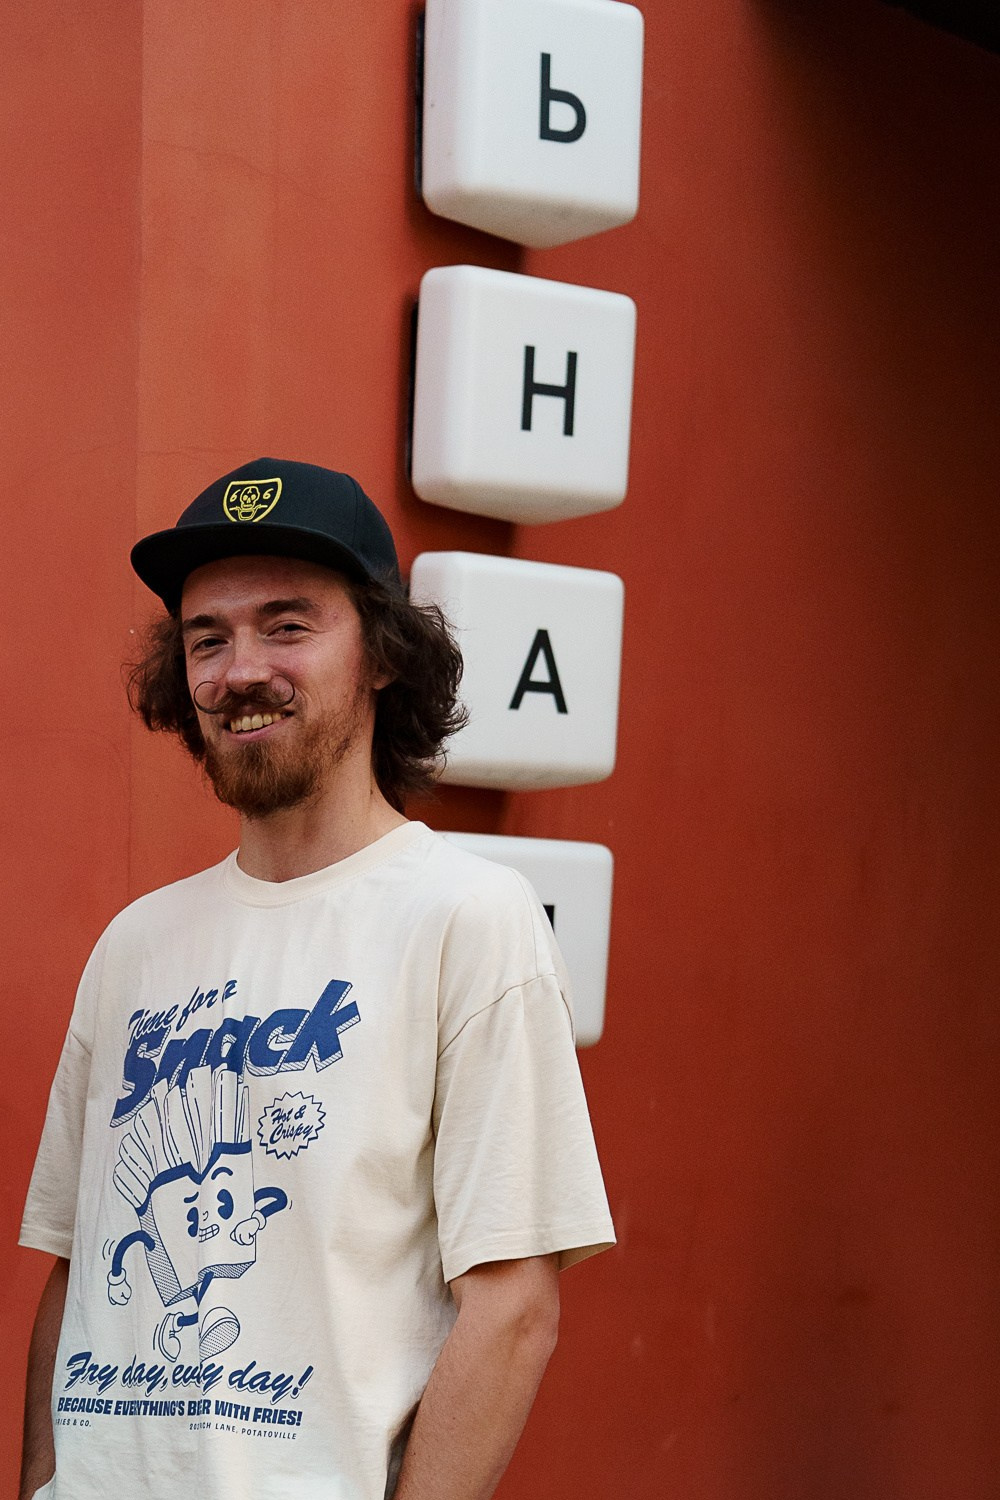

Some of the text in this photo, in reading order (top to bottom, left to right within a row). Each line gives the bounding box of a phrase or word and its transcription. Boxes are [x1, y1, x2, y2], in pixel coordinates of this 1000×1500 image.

[128, 1004, 179, 1046] Time
[176, 985, 218, 1031] for
[110, 979, 361, 1128] Snack
[270, 1104, 307, 1125] Hot &
[269, 1122, 314, 1145] Crispy
[63, 1351, 119, 1396] Fry
[121, 1354, 169, 1397] day,
[227, 1360, 315, 1406] day!
[57, 1396, 113, 1416] BECAUSE
[214, 1401, 251, 1422] WITH
[252, 1407, 303, 1427] FRIES!
[241, 1427, 298, 1440] POTATOVILLE
